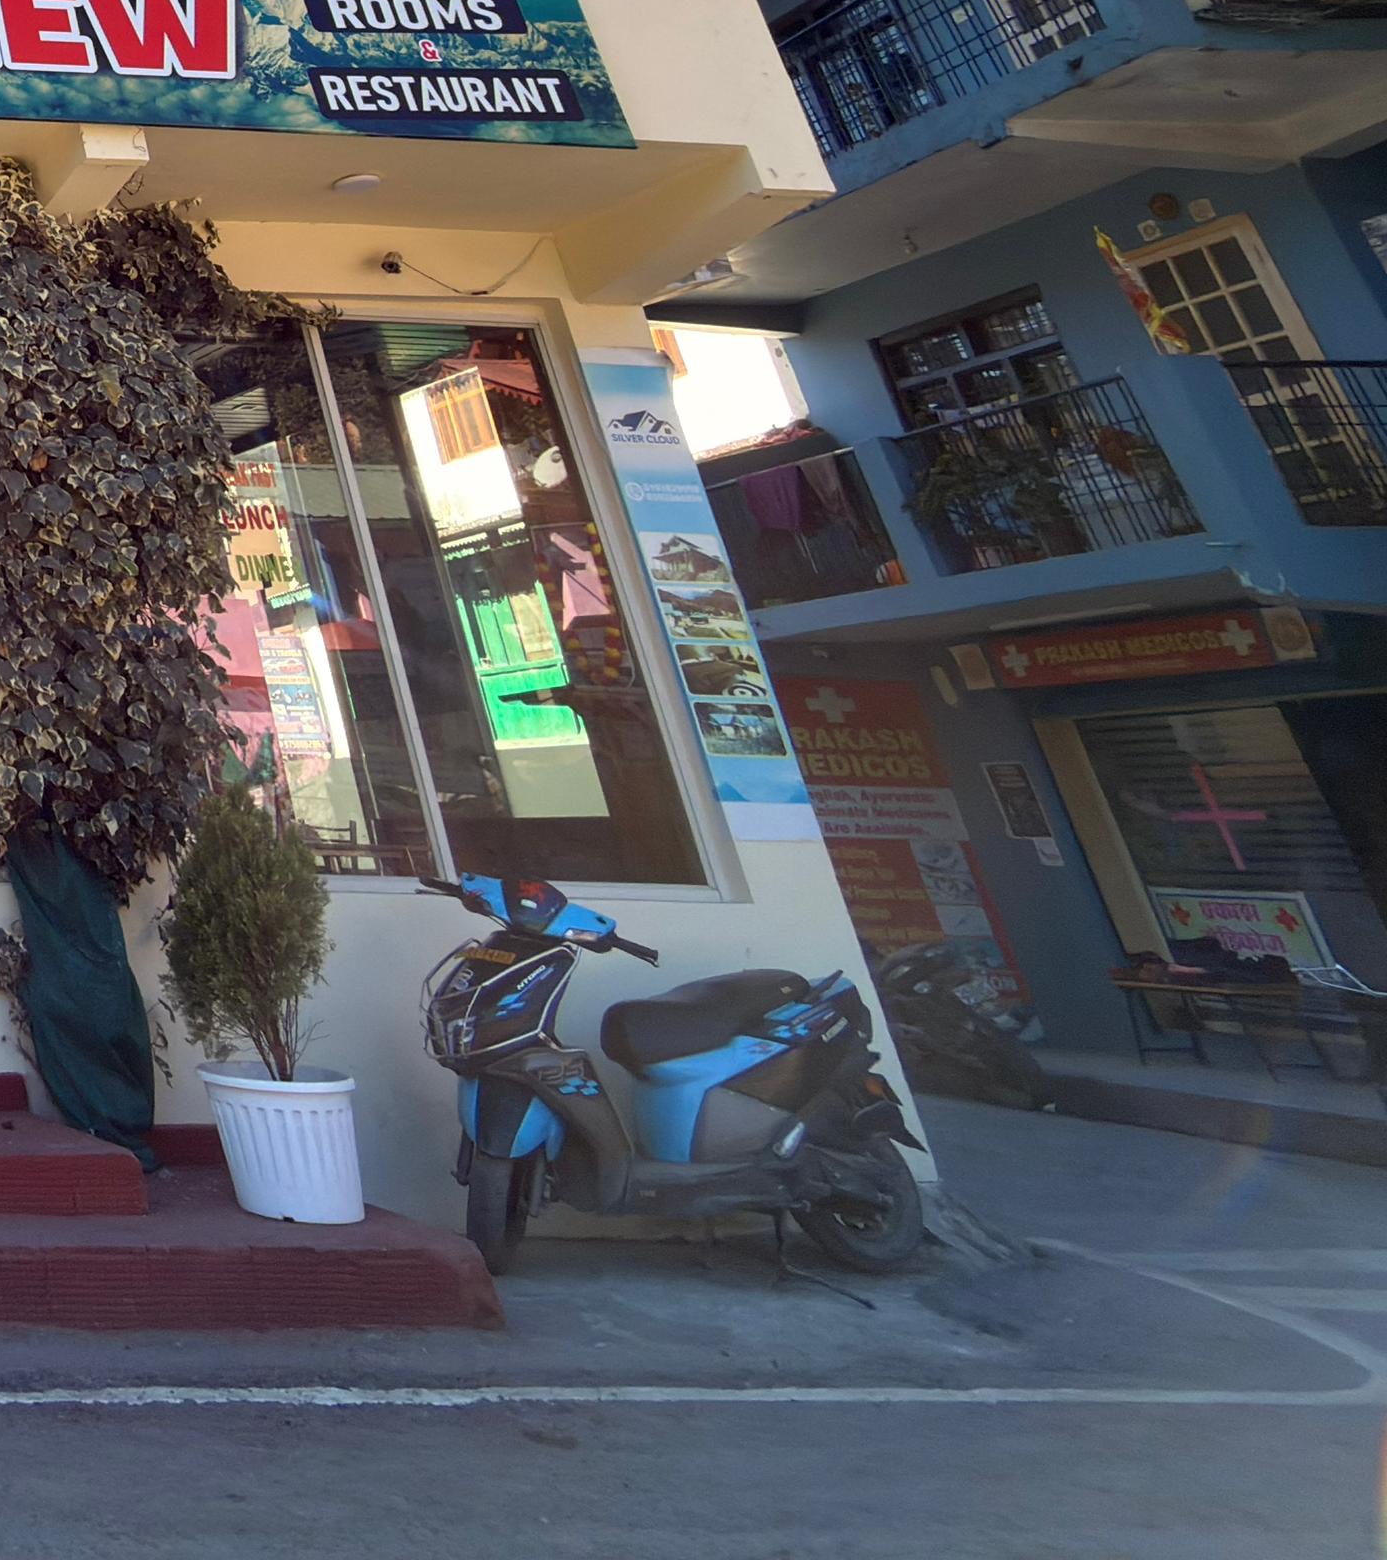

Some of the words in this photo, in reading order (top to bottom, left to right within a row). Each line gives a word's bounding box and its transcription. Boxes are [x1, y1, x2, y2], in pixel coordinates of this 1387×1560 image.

[418, 39, 443, 62] &
[319, 75, 566, 114] RESTAURANT
[611, 433, 645, 443] SILVER
[646, 435, 681, 445] CLOUD
[789, 726, 923, 751] RAKASH
